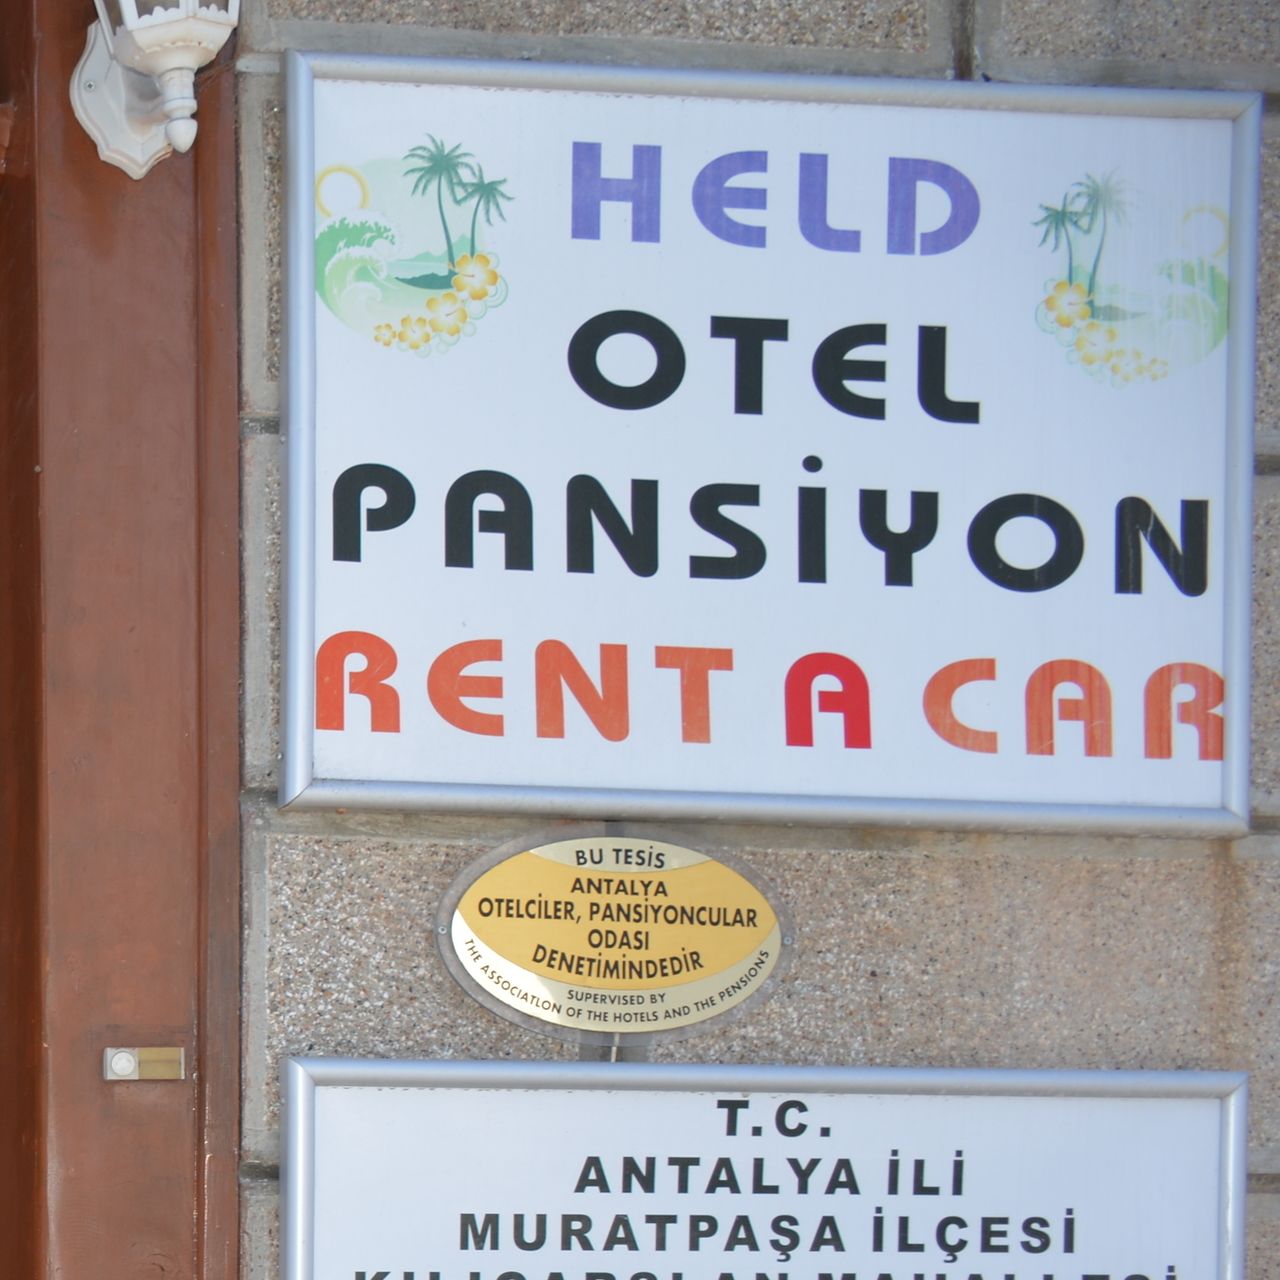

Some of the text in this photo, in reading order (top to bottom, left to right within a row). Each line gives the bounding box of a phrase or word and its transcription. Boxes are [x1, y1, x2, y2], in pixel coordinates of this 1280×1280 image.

[571, 141, 981, 256] HELD
[567, 309, 981, 425] OTEL
[332, 455, 1210, 598] PANSİYON
[314, 630, 1225, 761] RENT A CAR
[576, 845, 665, 869] BU TESİS
[571, 877, 668, 897] ANTALYA
[478, 893, 758, 928] OTELCİLER, PANSİYONCULAR
[587, 928, 649, 950] ODASI
[465, 938, 482, 963] THE
[566, 1007, 582, 1019] OF
[587, 1010, 609, 1022] THE
[613, 1011, 659, 1023] HOTELS
[663, 1005, 690, 1020] AND
[693, 995, 717, 1012] THE
[718, 949, 770, 1001] PENSIONS
[532, 943, 704, 979] DENETİMİNDEDİR
[567, 989, 666, 1006] SUPERVISED BY
[716, 1099, 832, 1138] T.C.
[574, 1149, 965, 1196] ANTALYA İLİ
[459, 1207, 1076, 1264] MURATPAŞA İLÇESİ
